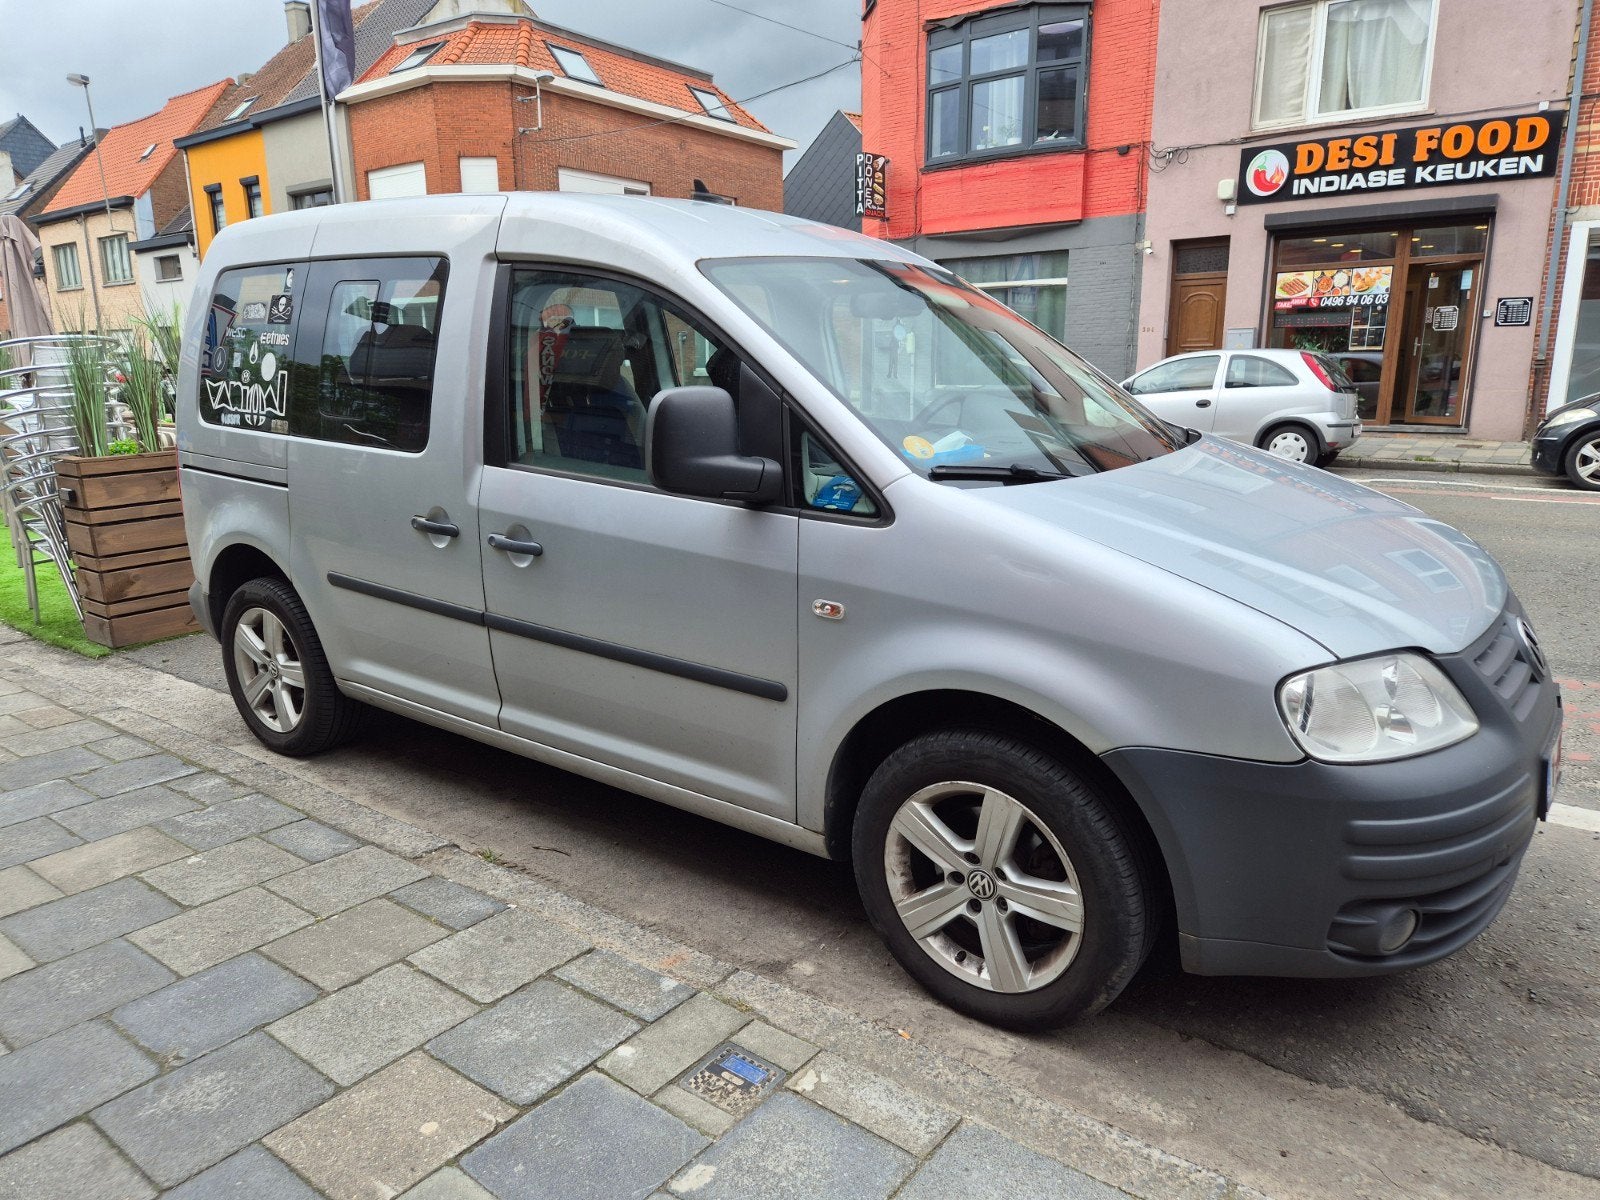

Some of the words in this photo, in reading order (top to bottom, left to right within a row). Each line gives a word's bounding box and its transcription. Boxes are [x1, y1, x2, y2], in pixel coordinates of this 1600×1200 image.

[1293, 133, 1398, 175] DESI
[1413, 116, 1550, 162] FOOD
[1292, 168, 1406, 196] INDIASE
[1414, 154, 1544, 184] KEUKEN
[1320, 296, 1344, 307] 0496
[1346, 295, 1359, 306] 94
[1360, 294, 1374, 305] 06
[1374, 294, 1389, 304] 03
